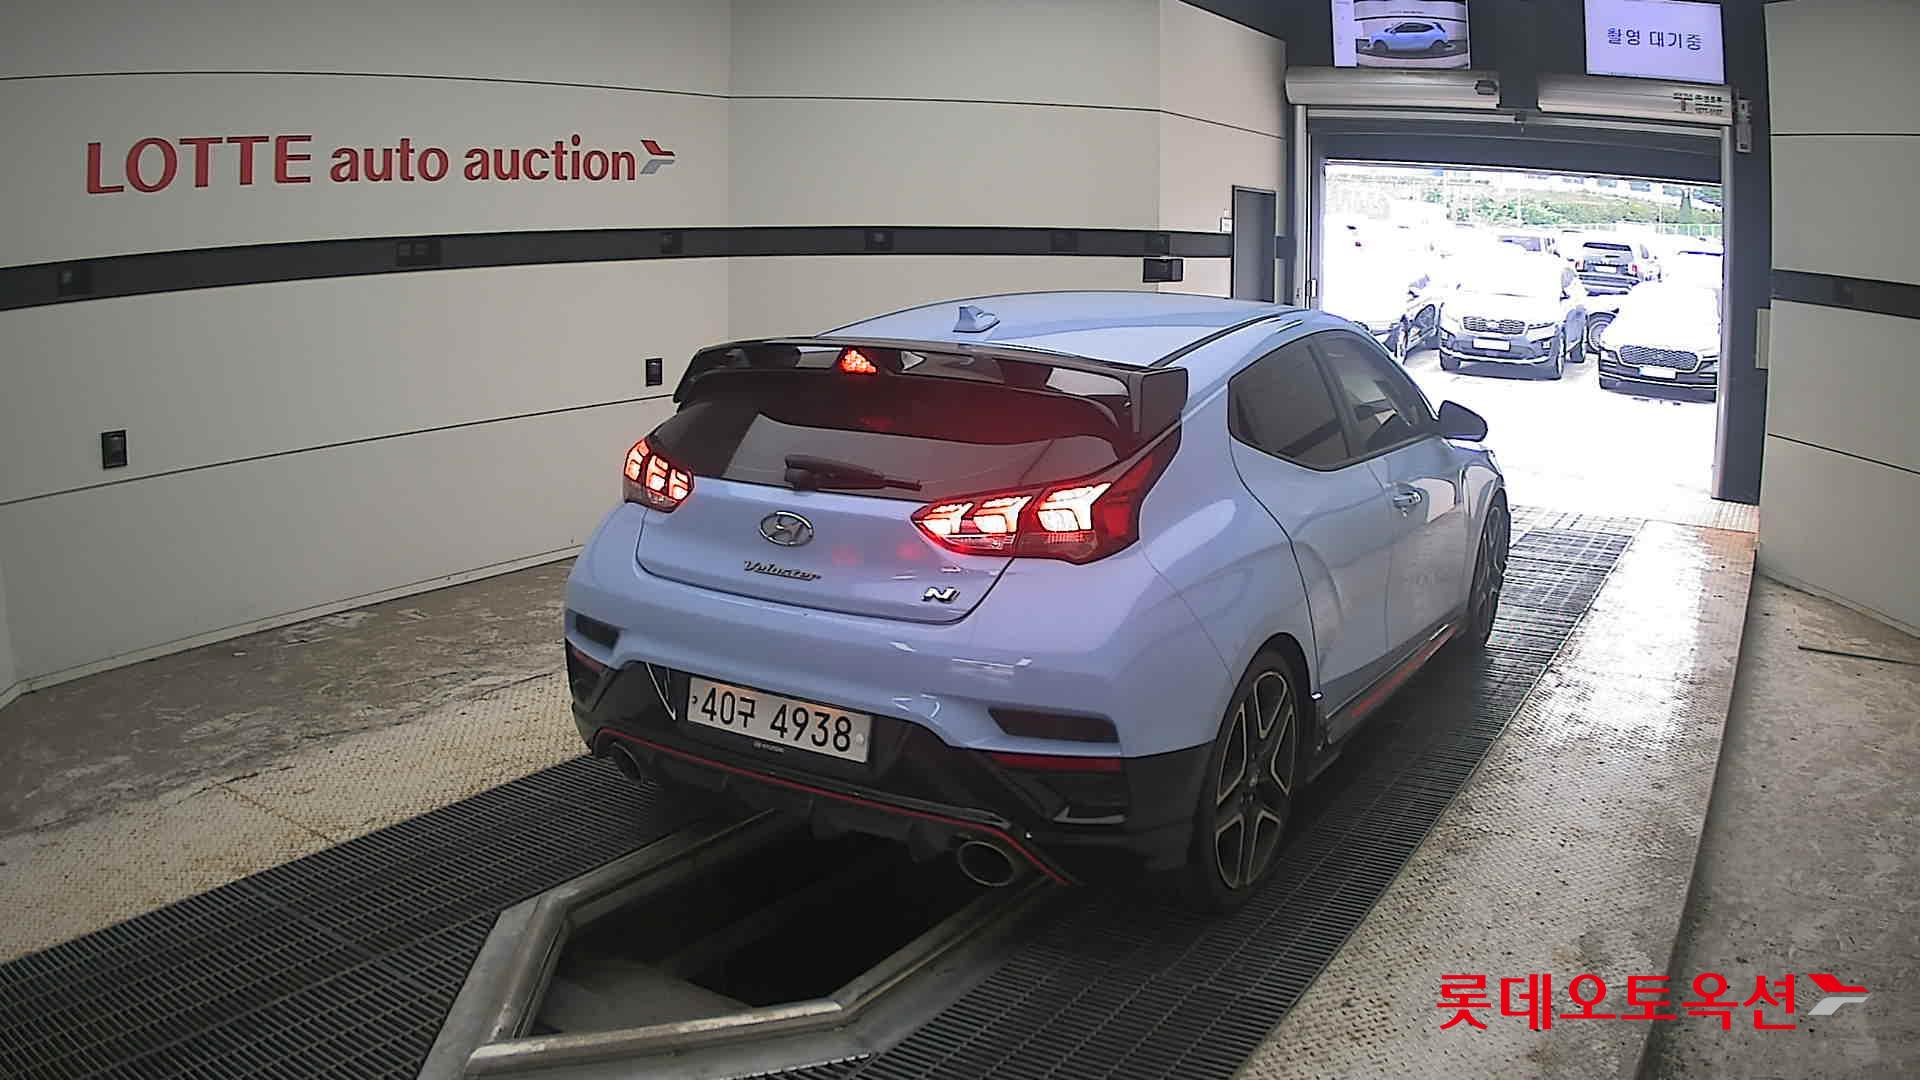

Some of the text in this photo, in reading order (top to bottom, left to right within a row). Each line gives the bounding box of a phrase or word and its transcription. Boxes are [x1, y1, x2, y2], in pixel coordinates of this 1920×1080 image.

[1607, 27, 1641, 46] 촬영
[86, 133, 637, 194] LOTTE auto auction
[700, 687, 852, 752] 40구 4938
